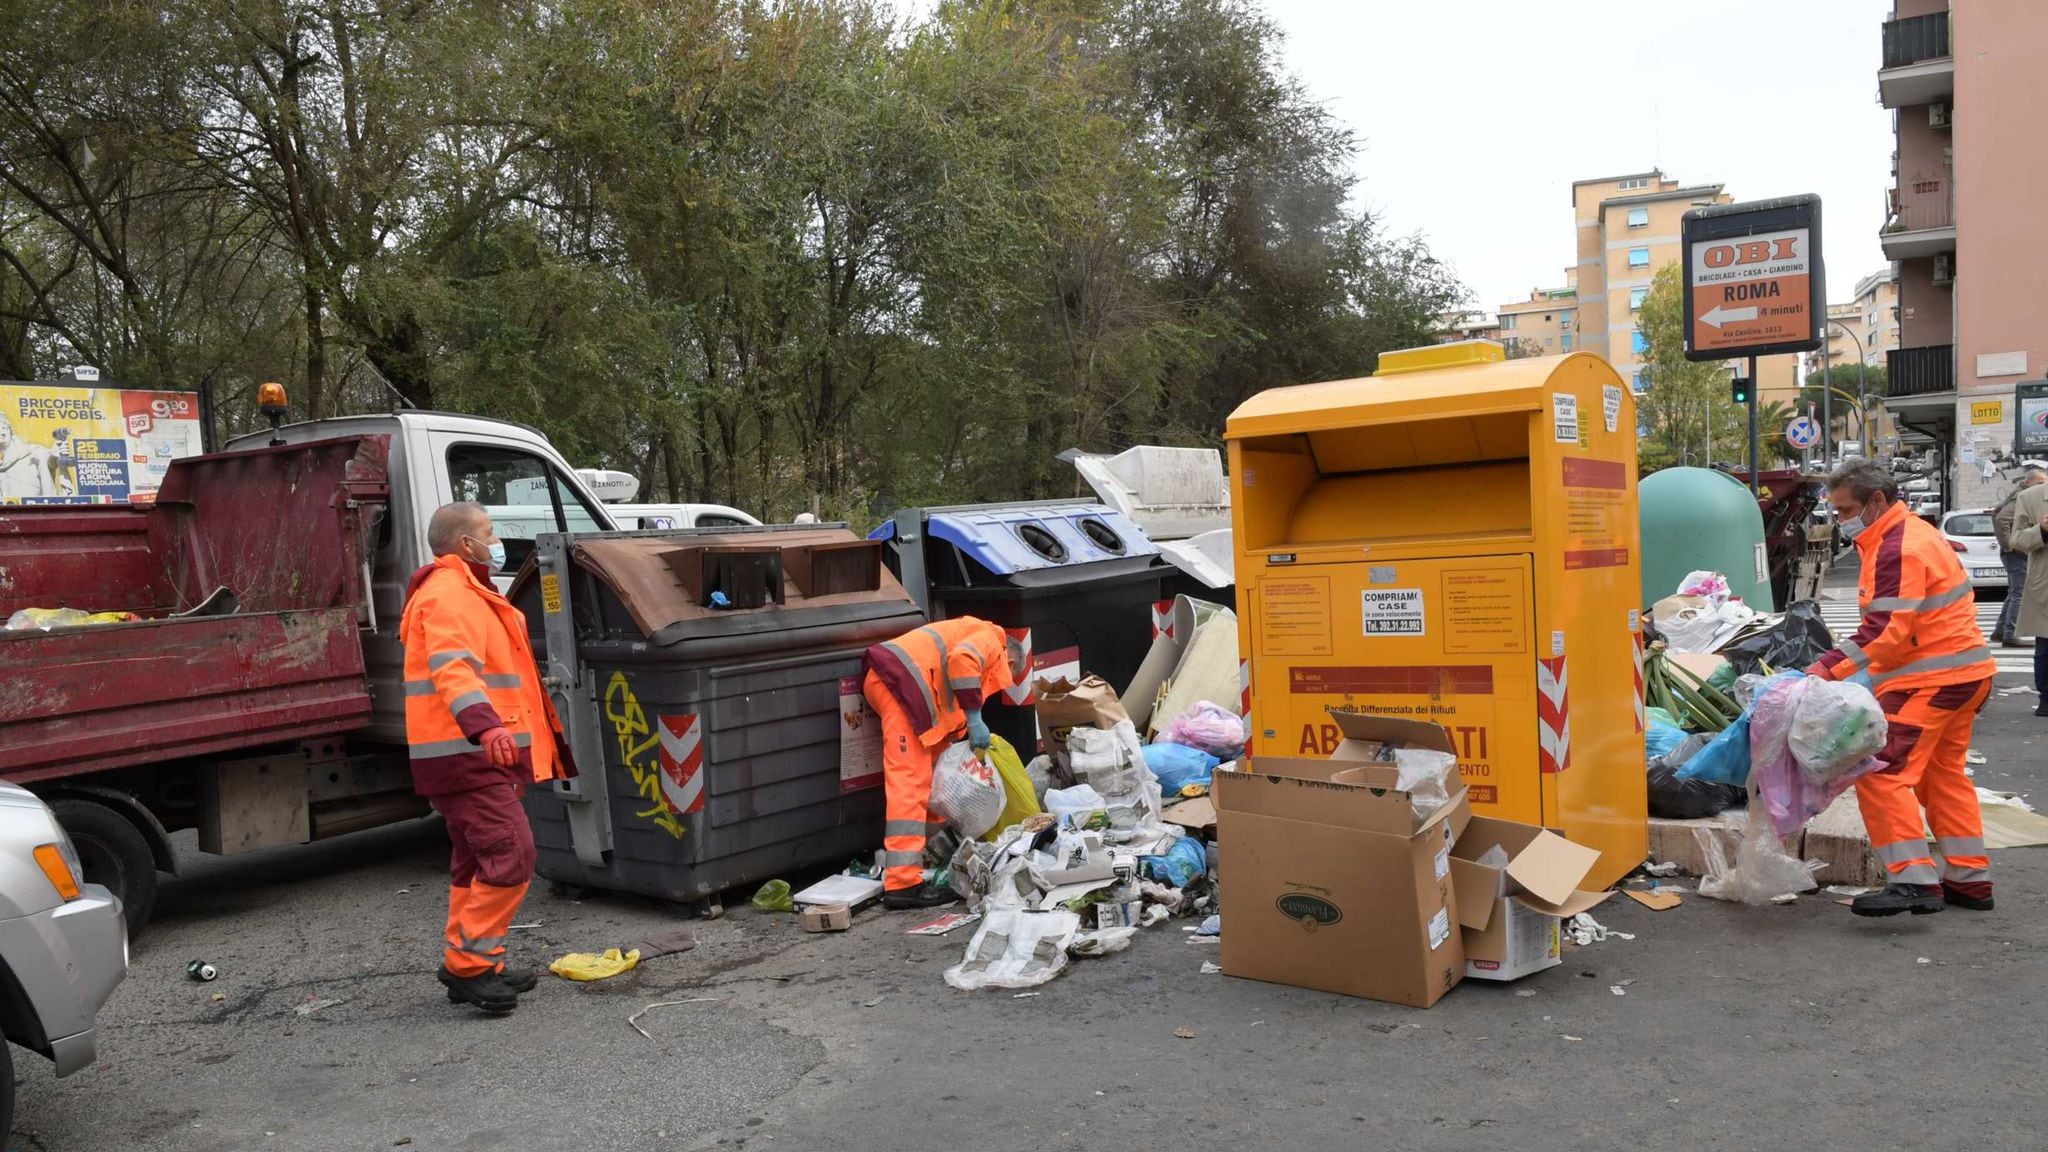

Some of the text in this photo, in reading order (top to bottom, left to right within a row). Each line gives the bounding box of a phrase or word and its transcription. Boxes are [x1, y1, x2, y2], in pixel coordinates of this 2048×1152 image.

[1704, 237, 1797, 269] OBI
[1698, 263, 1804, 282] BRICOLAGE CASA GIARDINO
[1723, 281, 1780, 302] ROMA
[1760, 302, 1803, 317] 4 minuti
[20, 409, 106, 420] FATE VOBIS.
[1973, 408, 1999, 418] LOTTO
[77, 441, 98, 452] 25
[1378, 602, 1407, 610] CASE
[1361, 705, 1413, 715] Differenziata
[1415, 705, 1428, 715] dei
[1430, 705, 1456, 715] Rifiuti
